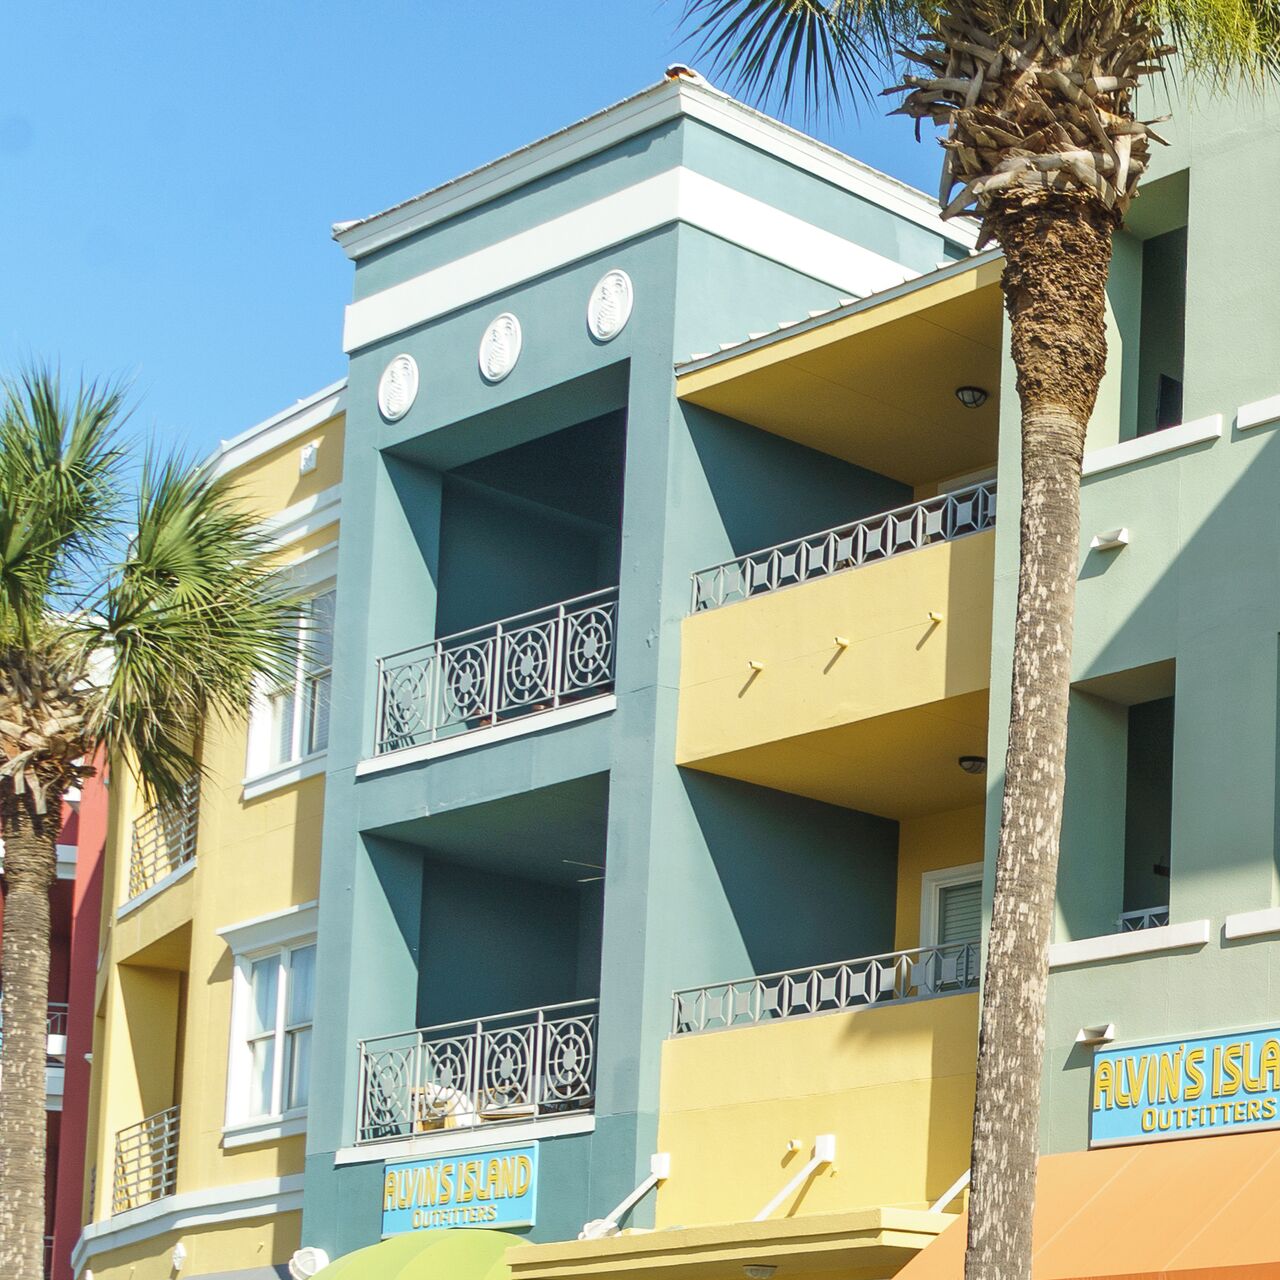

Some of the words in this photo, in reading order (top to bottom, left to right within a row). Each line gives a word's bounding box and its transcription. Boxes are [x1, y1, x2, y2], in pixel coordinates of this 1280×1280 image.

[1093, 1043, 1205, 1110] ALVIN'S
[1141, 1097, 1277, 1132] OUTFITTERS
[383, 1161, 453, 1212] ALVIN'S
[456, 1155, 532, 1204] ISLAND
[412, 1204, 497, 1229] OUTFITTERS
